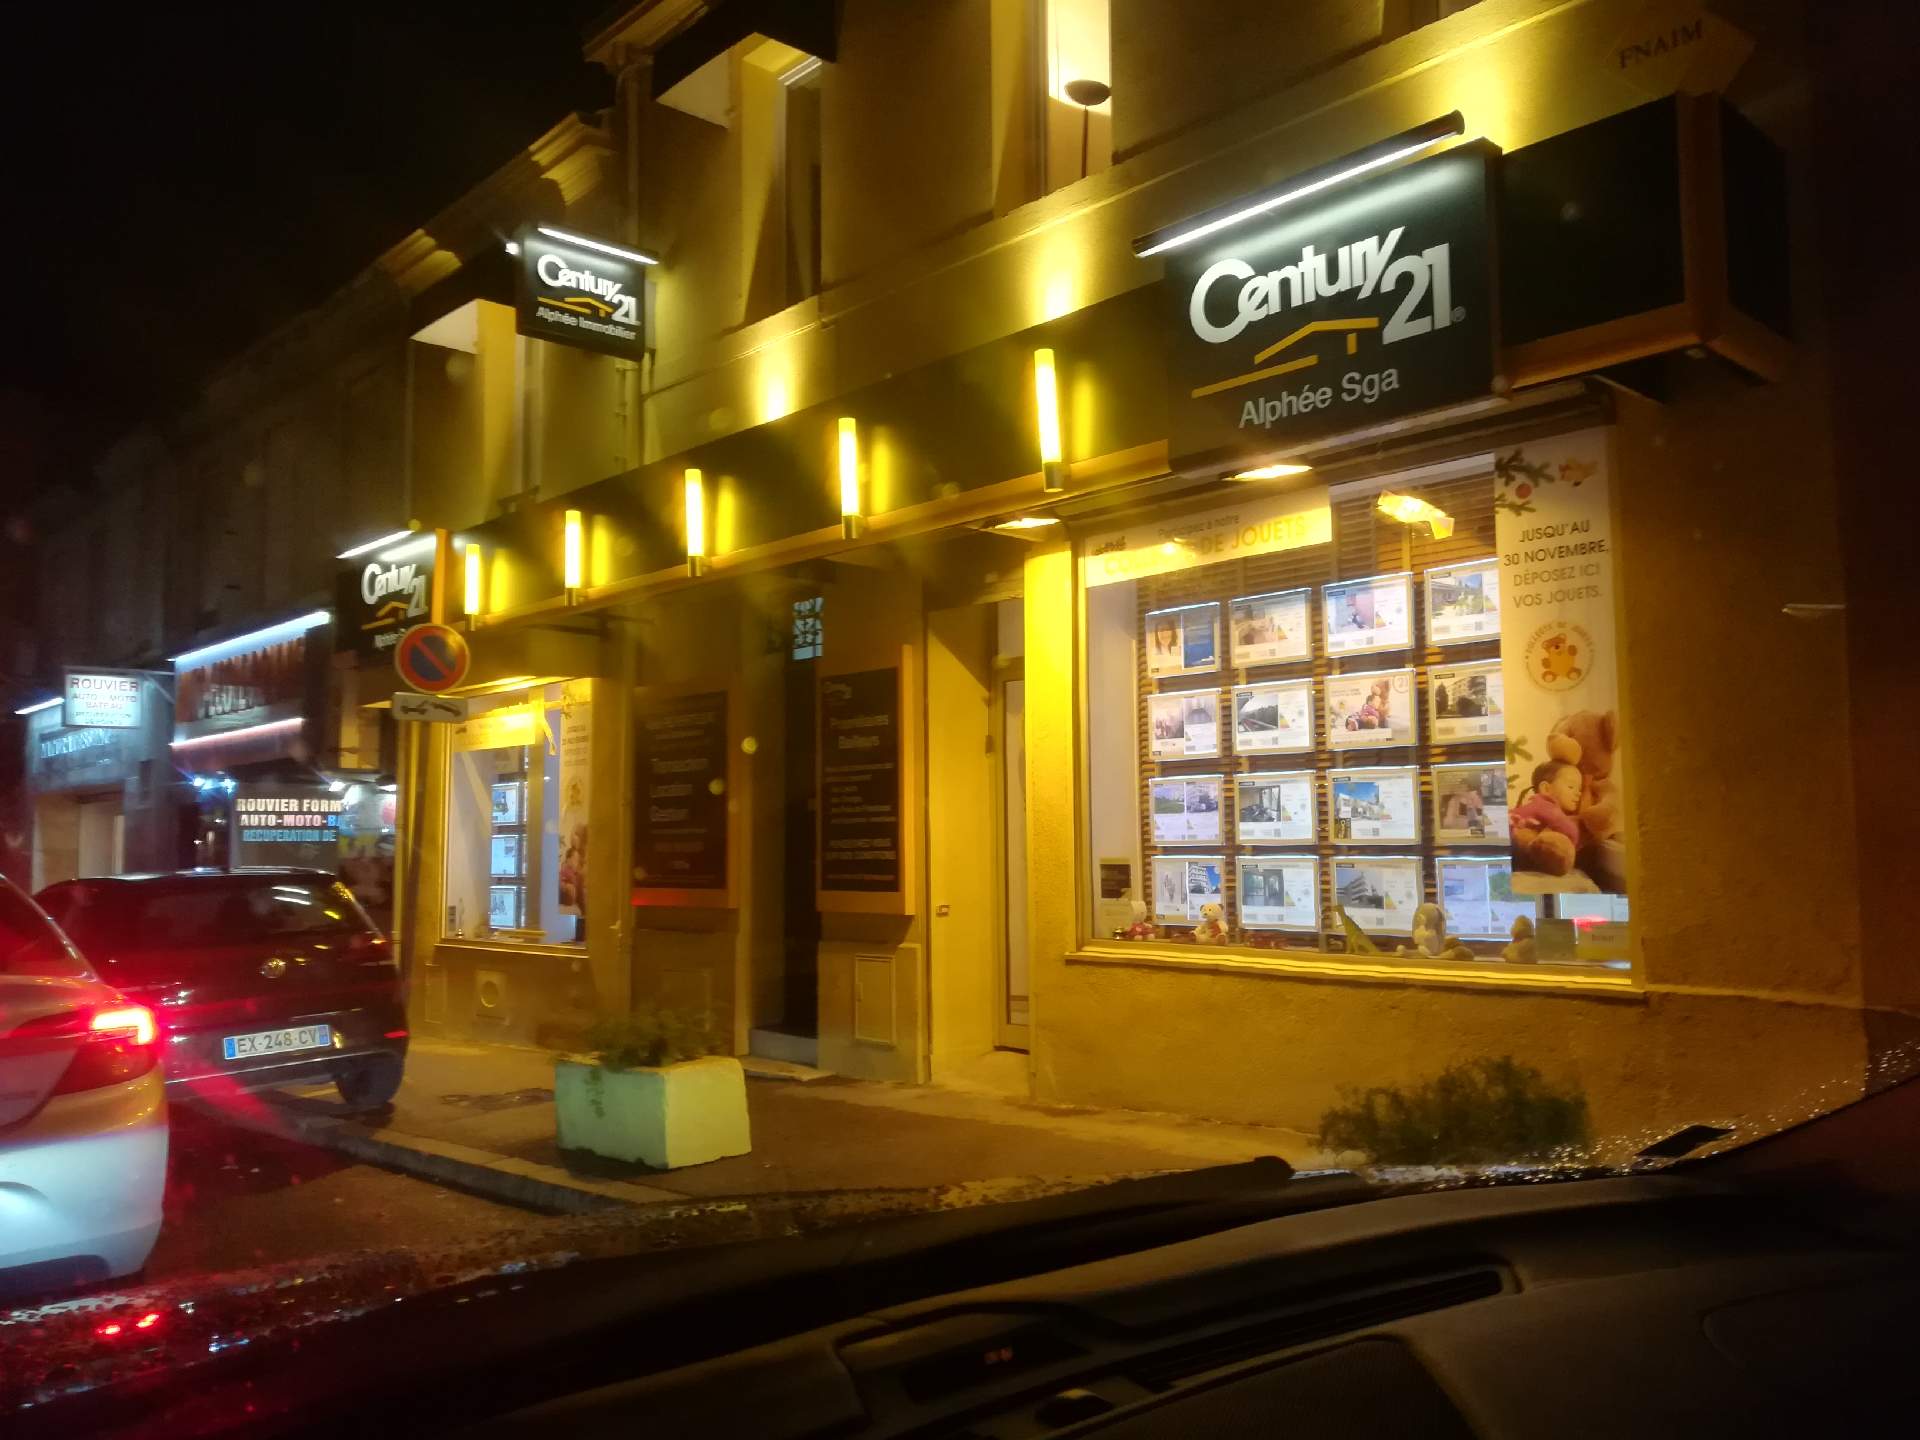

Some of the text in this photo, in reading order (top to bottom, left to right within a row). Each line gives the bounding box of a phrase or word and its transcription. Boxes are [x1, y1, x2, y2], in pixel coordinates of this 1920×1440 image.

[1617, 18, 1703, 69] FNAIM
[537, 254, 641, 326] Century 21
[1190, 226, 1453, 344] Century 21
[1239, 368, 1400, 428] Alphée Sga
[1200, 516, 1306, 555] DE JOUETS
[1503, 553, 1520, 567] 30
[1579, 563, 1600, 577] ICI
[1513, 593, 1542, 608] VOS
[71, 677, 139, 693] ROUVIER
[236, 798, 299, 812] ROUVIER
